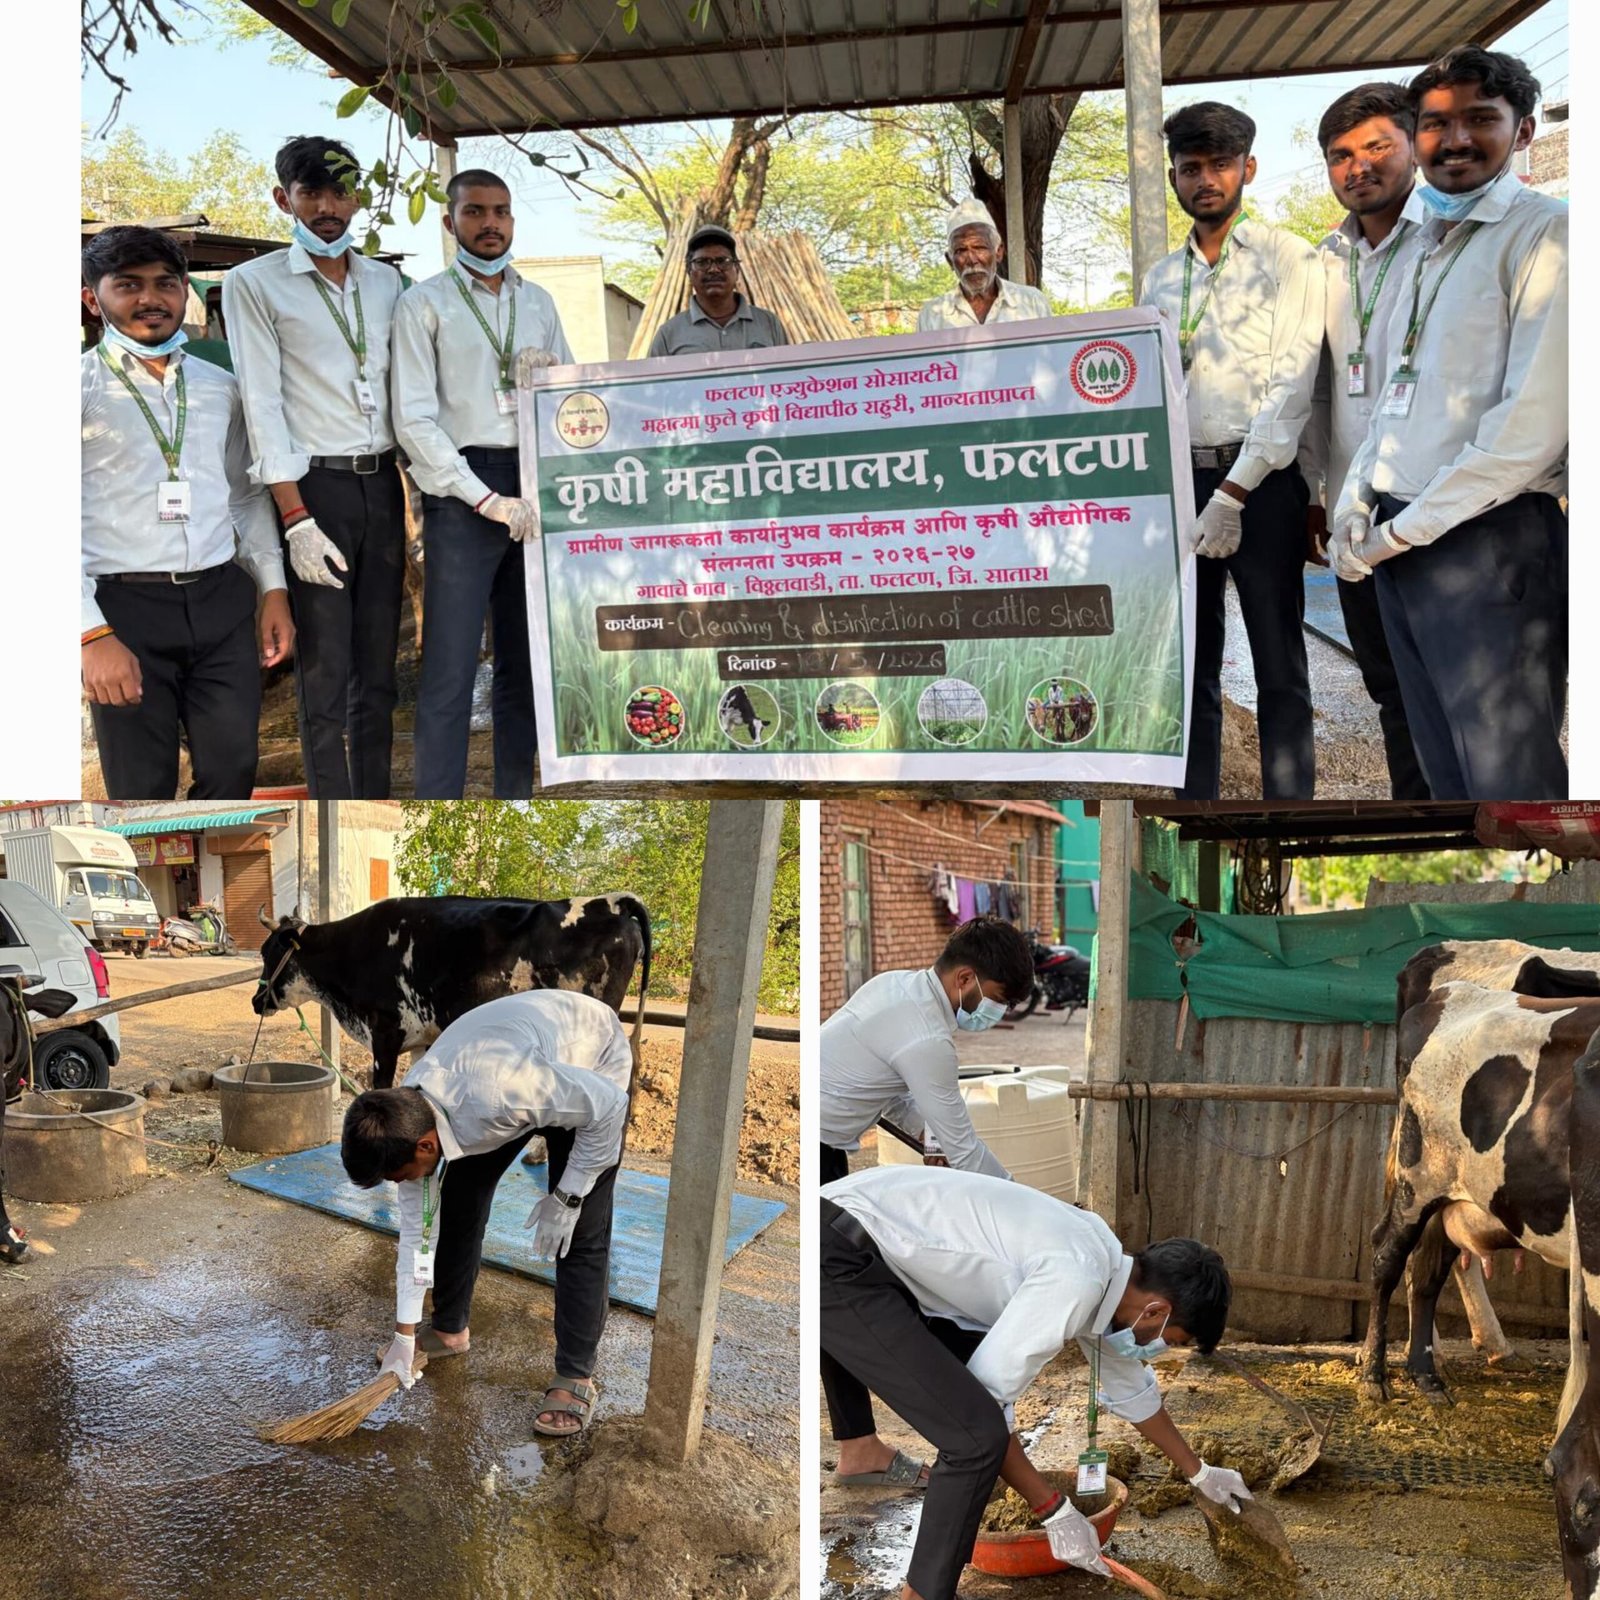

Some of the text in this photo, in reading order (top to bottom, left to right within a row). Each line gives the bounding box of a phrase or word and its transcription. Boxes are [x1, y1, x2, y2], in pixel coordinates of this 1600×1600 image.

[705, 361, 958, 404] फलटण एज्युकेशन सोसायटीचे
[641, 386, 1036, 434] महात्मा फुले कृषी विद्यापीठ राहुरी, मान्यताप्राप्त
[554, 432, 1149, 524] कृषी महाविद्यालय, फलटण
[567, 501, 1131, 555] ग्रामीण जागरूकता कार्यानुभव कार्यक्रम आणि कृषी औद्योगिक
[702, 553, 775, 574] संलग्नता
[783, 551, 842, 569] उपक्रम
[874, 544, 976, 565] २०२६-२७
[637, 579, 688, 600] गावाचे
[693, 581, 726, 597] नाव
[839, 576, 865, 590] ता.
[869, 571, 943, 590] फलटण,
[948, 565, 978, 586] जि.
[985, 566, 1049, 584] सातारा
[604, 615, 664, 632] कार्यक्रम
[677, 610, 773, 641] Cleaning
[812, 600, 933, 636] disinfection
[939, 596, 963, 630] of
[972, 594, 1041, 628] cattle
[1050, 592, 1114, 630] shed
[727, 654, 777, 672] दिनांक
